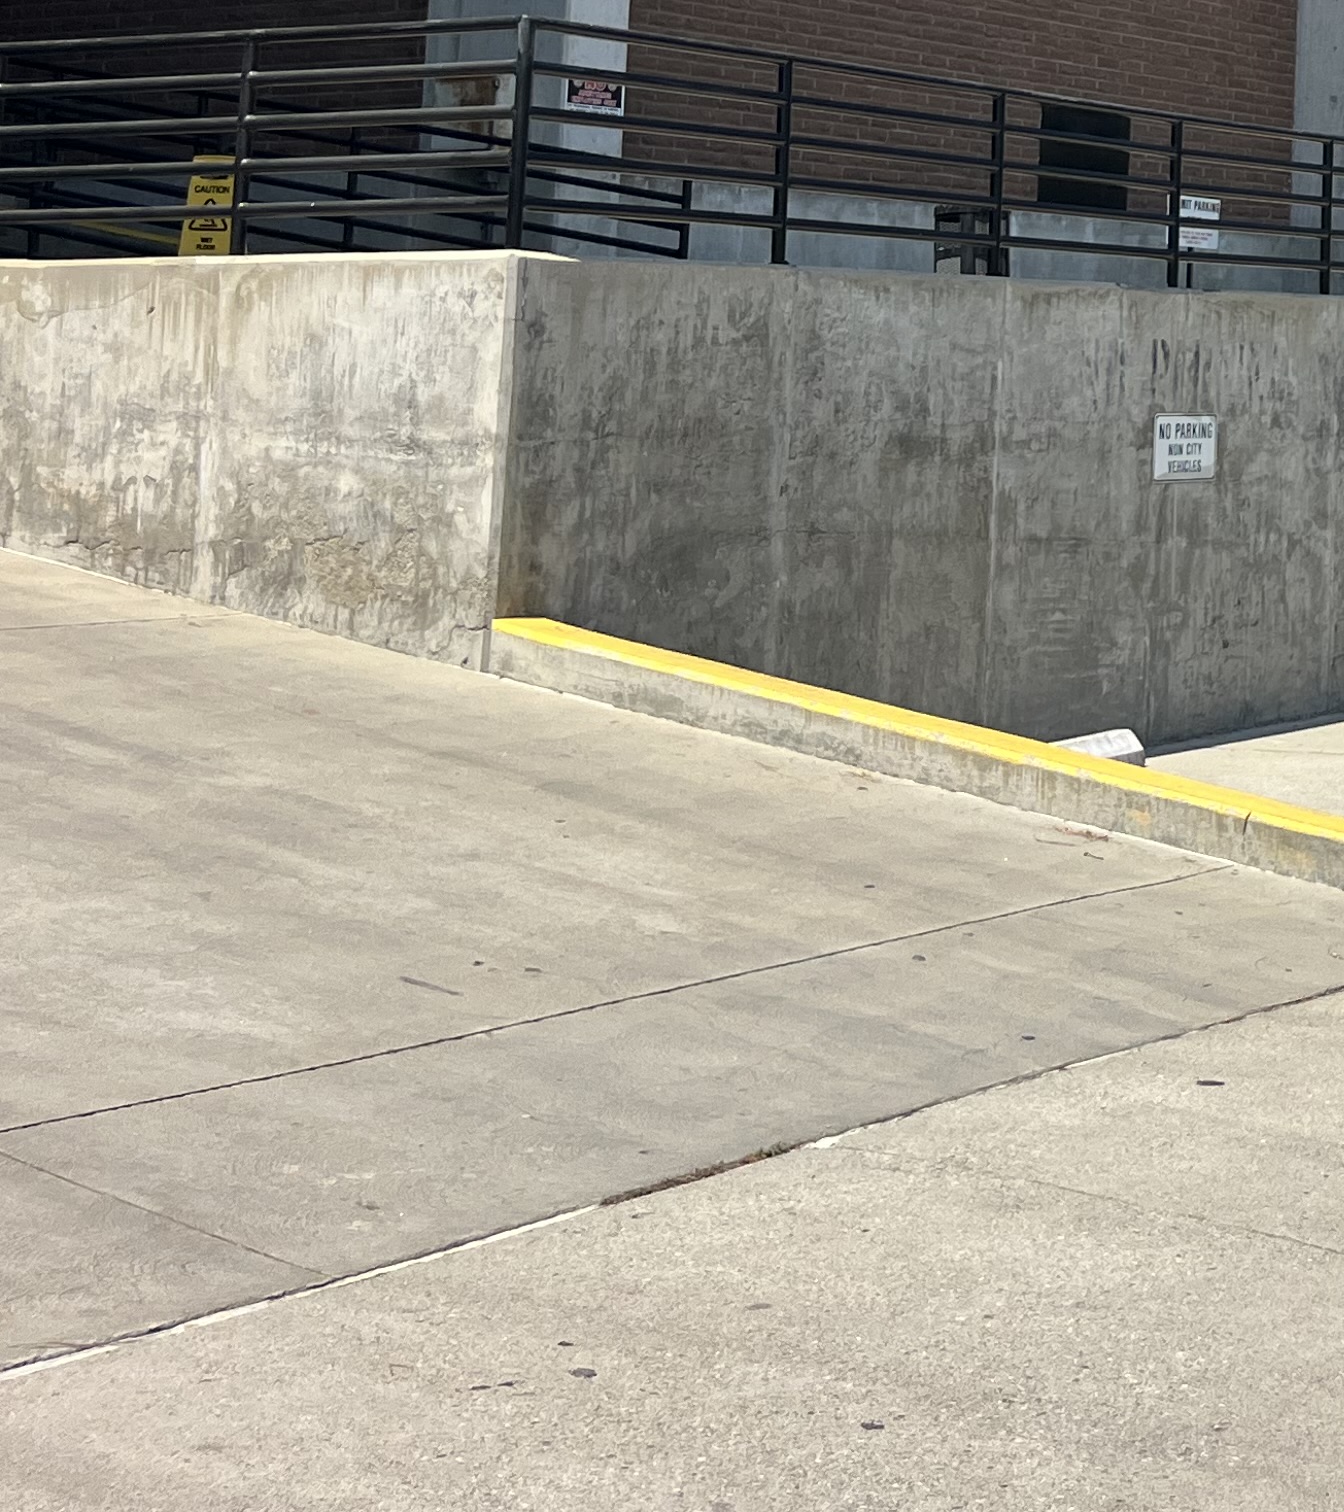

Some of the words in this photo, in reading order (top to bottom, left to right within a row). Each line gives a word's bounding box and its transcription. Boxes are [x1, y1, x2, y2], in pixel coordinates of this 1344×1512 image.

[194, 185, 230, 194] CAUTION
[1159, 423, 1171, 440] NO
[1175, 422, 1213, 440] PARKING
[1168, 443, 1184, 456] NON
[1186, 442, 1202, 455] CITY
[1168, 459, 1202, 474] VEHICLES
